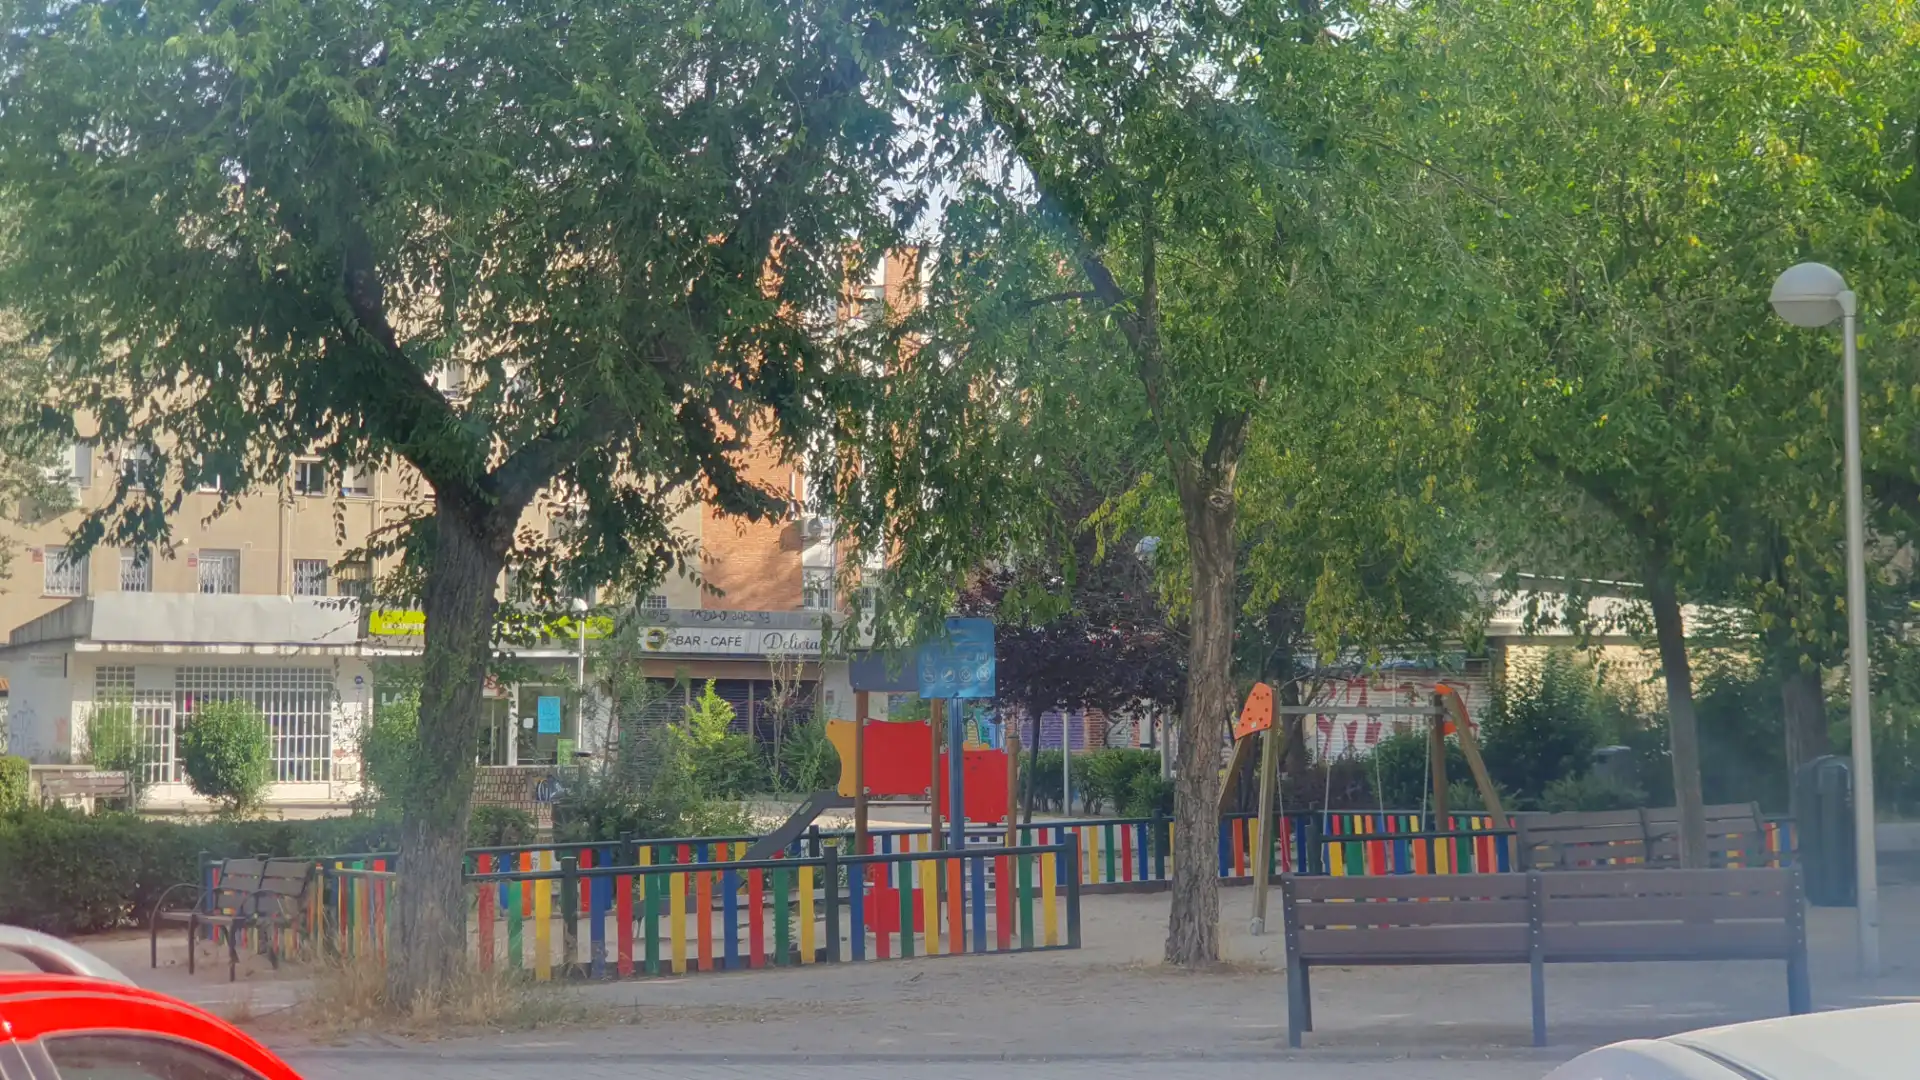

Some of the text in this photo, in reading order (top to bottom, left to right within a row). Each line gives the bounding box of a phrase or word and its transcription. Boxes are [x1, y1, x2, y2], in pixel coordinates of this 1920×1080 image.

[675, 636, 700, 646] BAR
[711, 635, 742, 647] CAFÉ
[763, 632, 826, 650] Delicia
